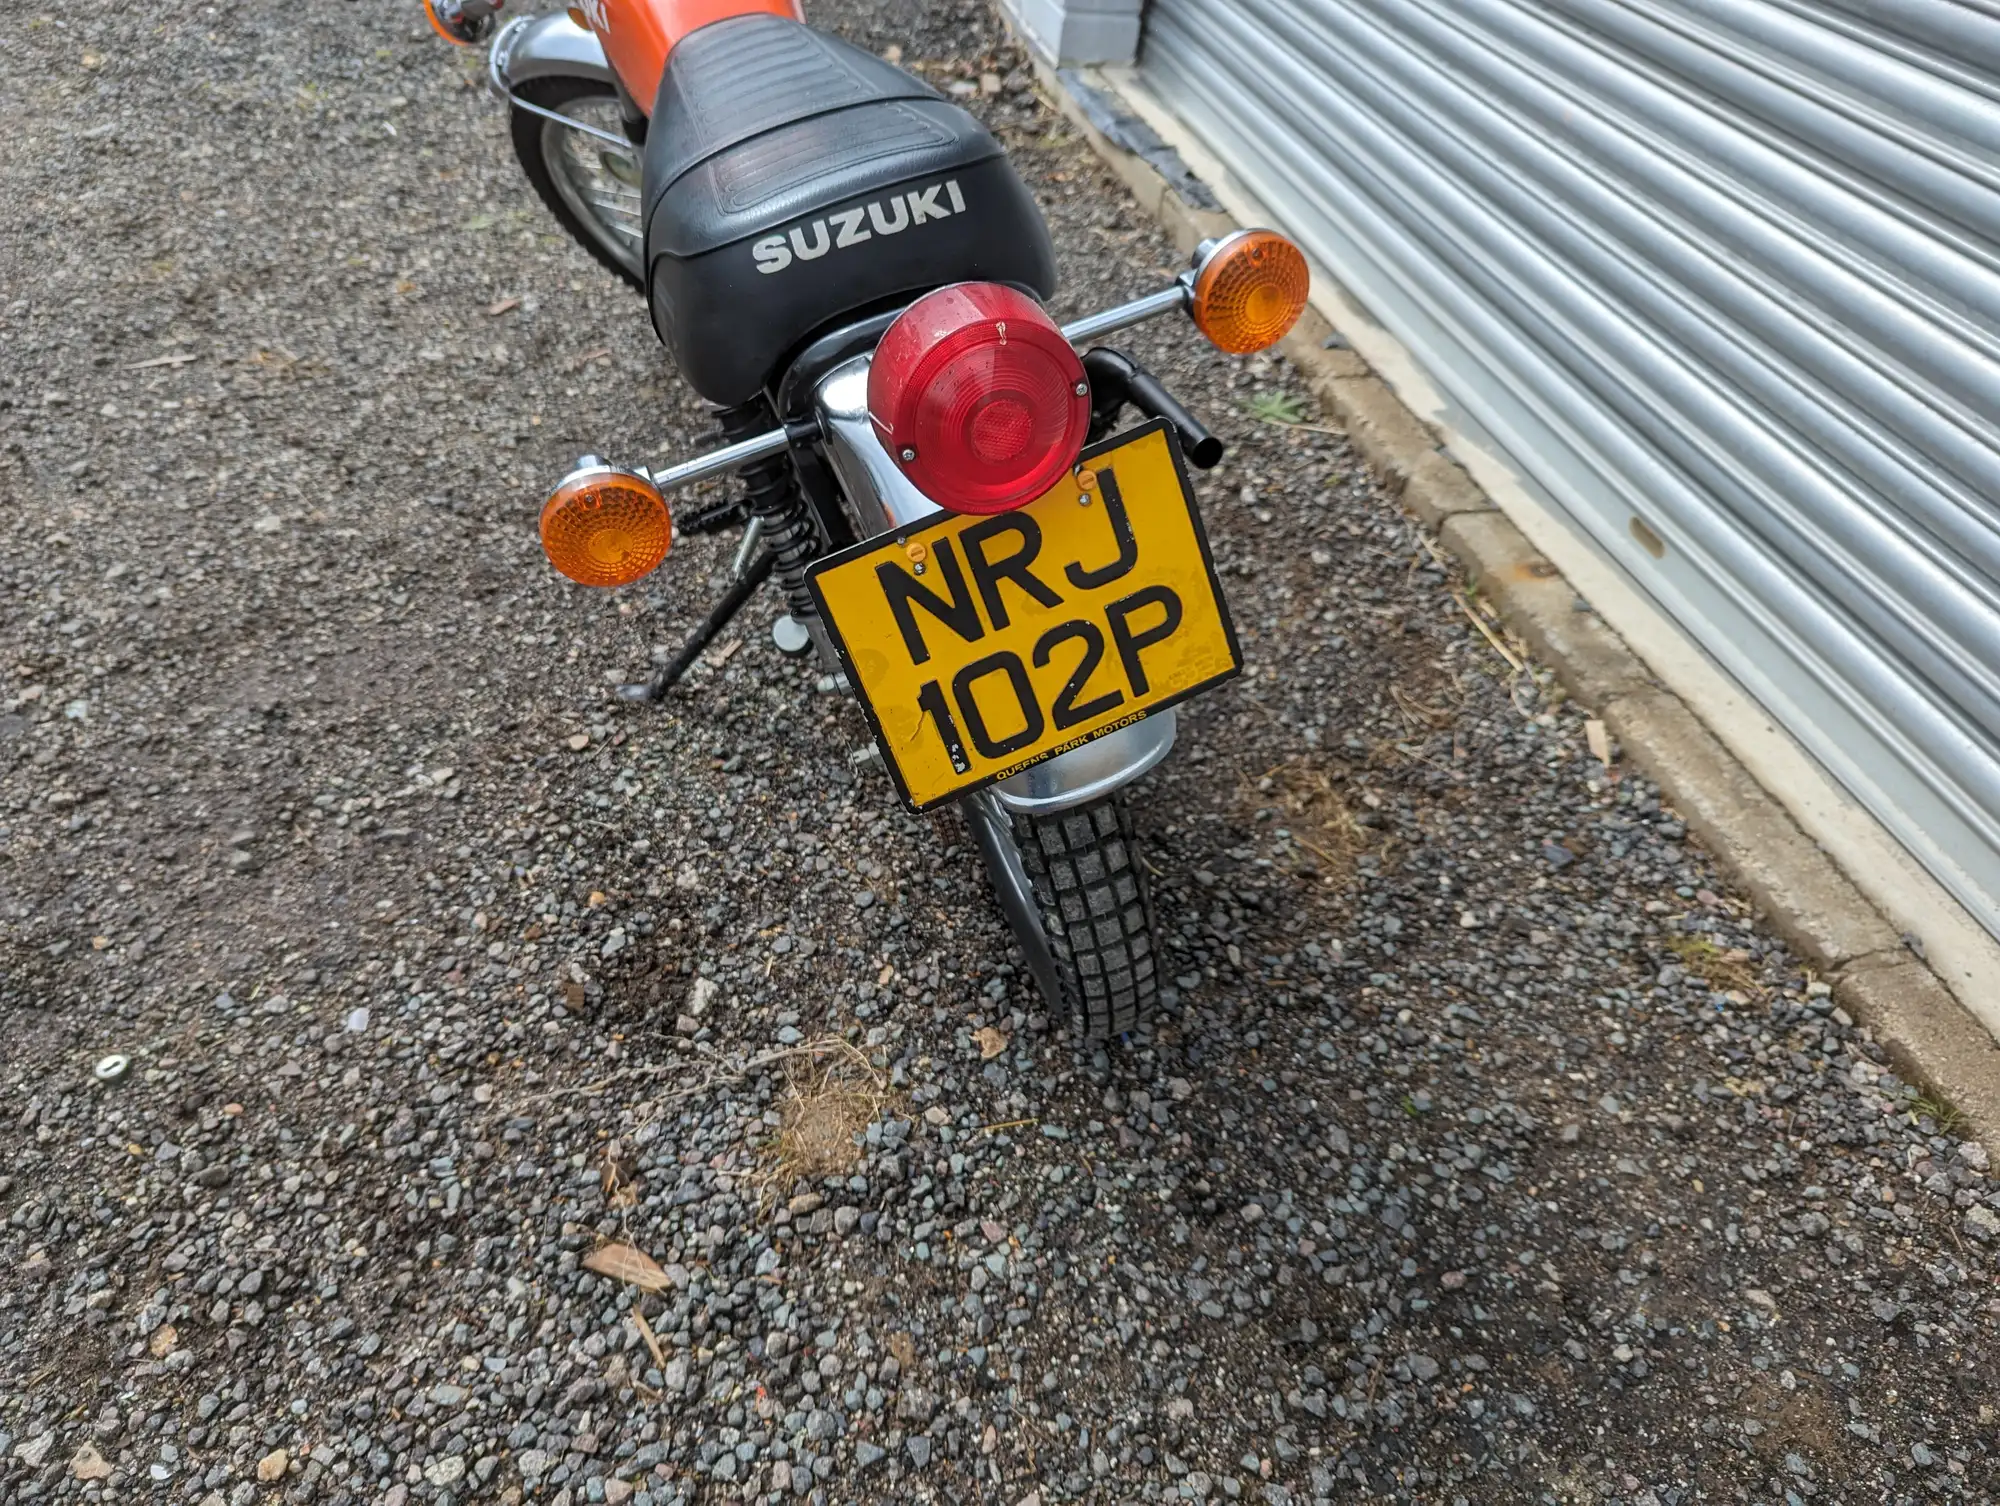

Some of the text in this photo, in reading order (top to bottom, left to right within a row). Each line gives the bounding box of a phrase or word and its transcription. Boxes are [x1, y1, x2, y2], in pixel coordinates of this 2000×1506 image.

[752, 179, 966, 274] SUZUKI
[874, 467, 1138, 666] NRJ
[917, 584, 1183, 776] 102P
[1054, 735, 1089, 756] PARK
[1093, 710, 1147, 739] MOTORS
